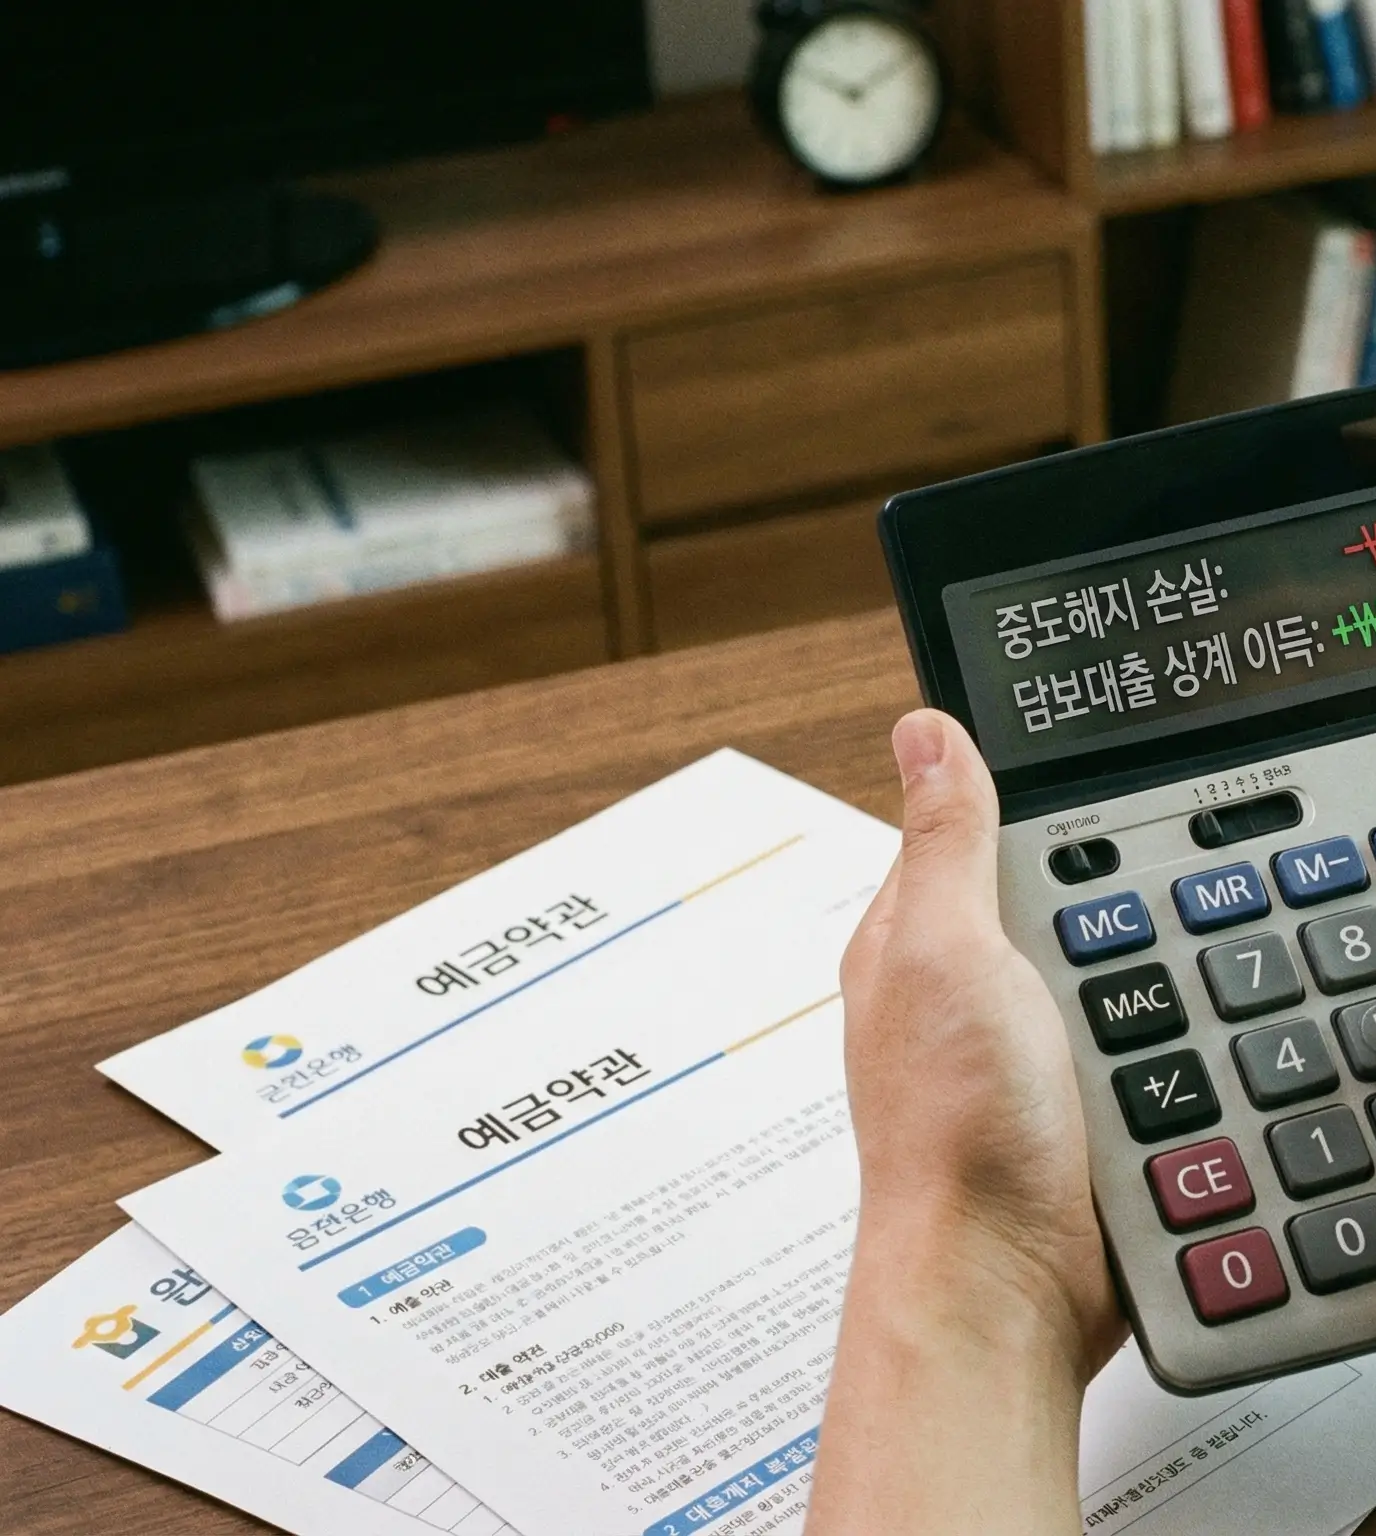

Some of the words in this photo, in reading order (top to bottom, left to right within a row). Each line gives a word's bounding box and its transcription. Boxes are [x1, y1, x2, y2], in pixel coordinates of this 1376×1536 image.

[995, 577, 1140, 660] 중도해지
[1146, 557, 1229, 625] 손실:
[1012, 651, 1158, 733] 담보대출
[1163, 631, 1238, 698] 상계
[1243, 615, 1325, 676] 이득:
[1194, 874, 1254, 912] MR
[1077, 903, 1139, 942] MC
[415, 893, 610, 997] 예금약관
[1339, 924, 1372, 962] 8
[1235, 949, 1263, 989] 7
[1101, 983, 1171, 1022] MAC
[1275, 1036, 1306, 1073] 4
[456, 1047, 652, 1150] 예금약관
[1309, 1125, 1335, 1164] 1
[1176, 1156, 1233, 1200] CE
[1335, 1216, 1366, 1257] 0
[1221, 1249, 1253, 1291] 0
